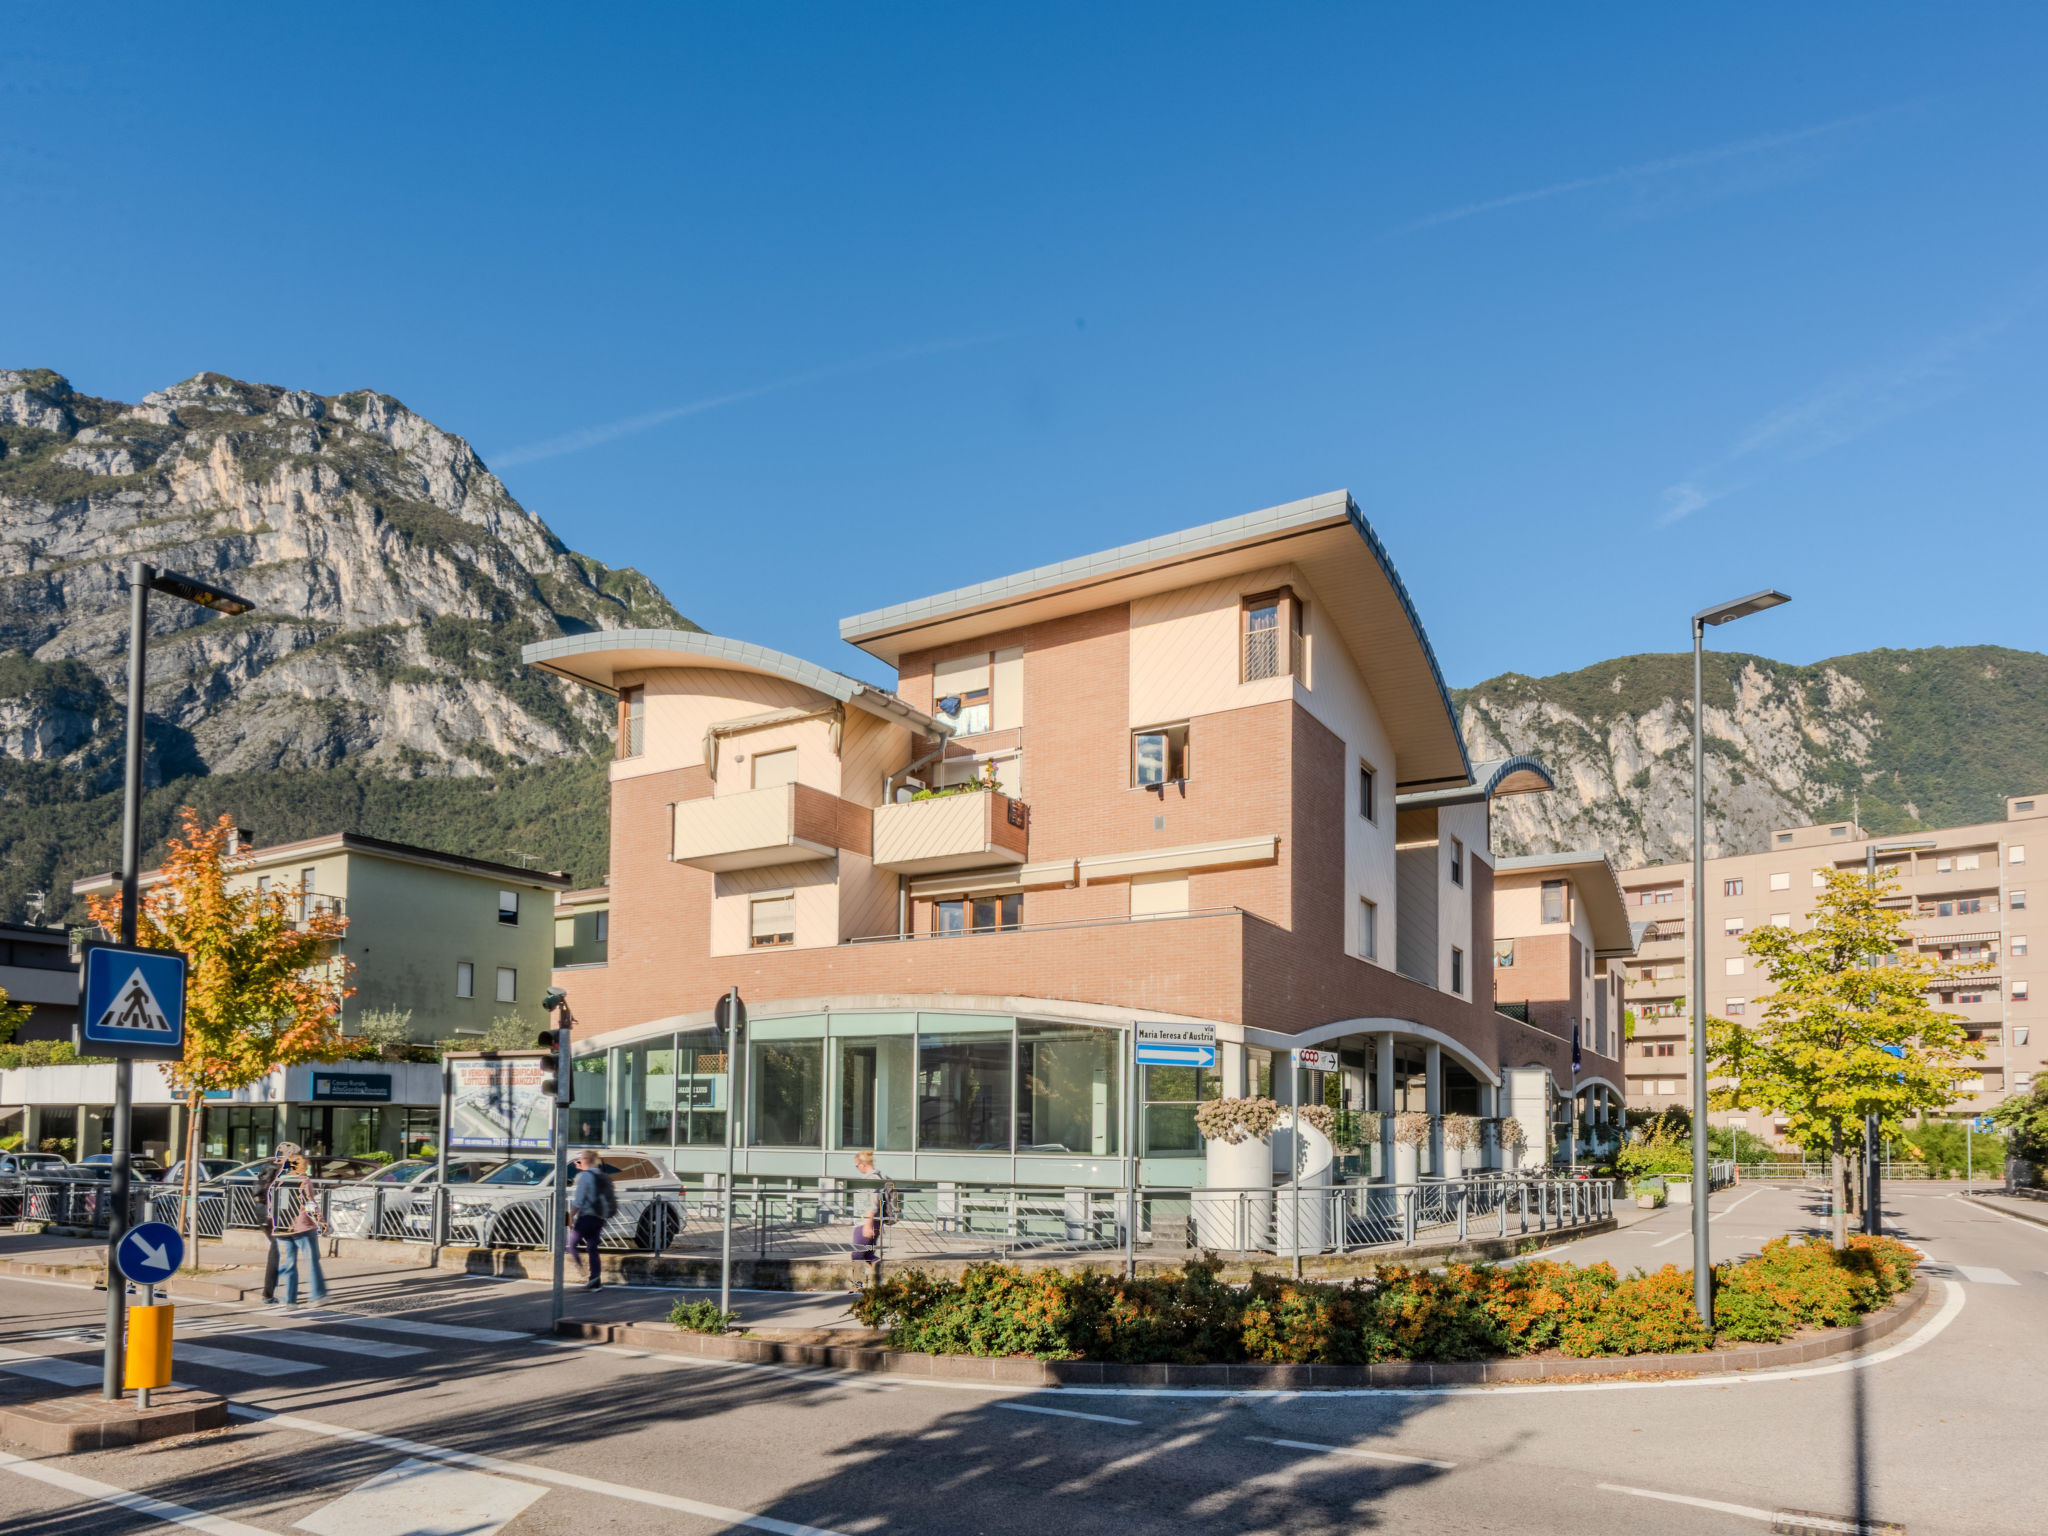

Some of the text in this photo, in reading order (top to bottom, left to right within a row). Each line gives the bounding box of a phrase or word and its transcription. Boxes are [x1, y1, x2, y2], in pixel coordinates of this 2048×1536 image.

[1139, 1029, 1214, 1041] Maria Teresa d'Austria
